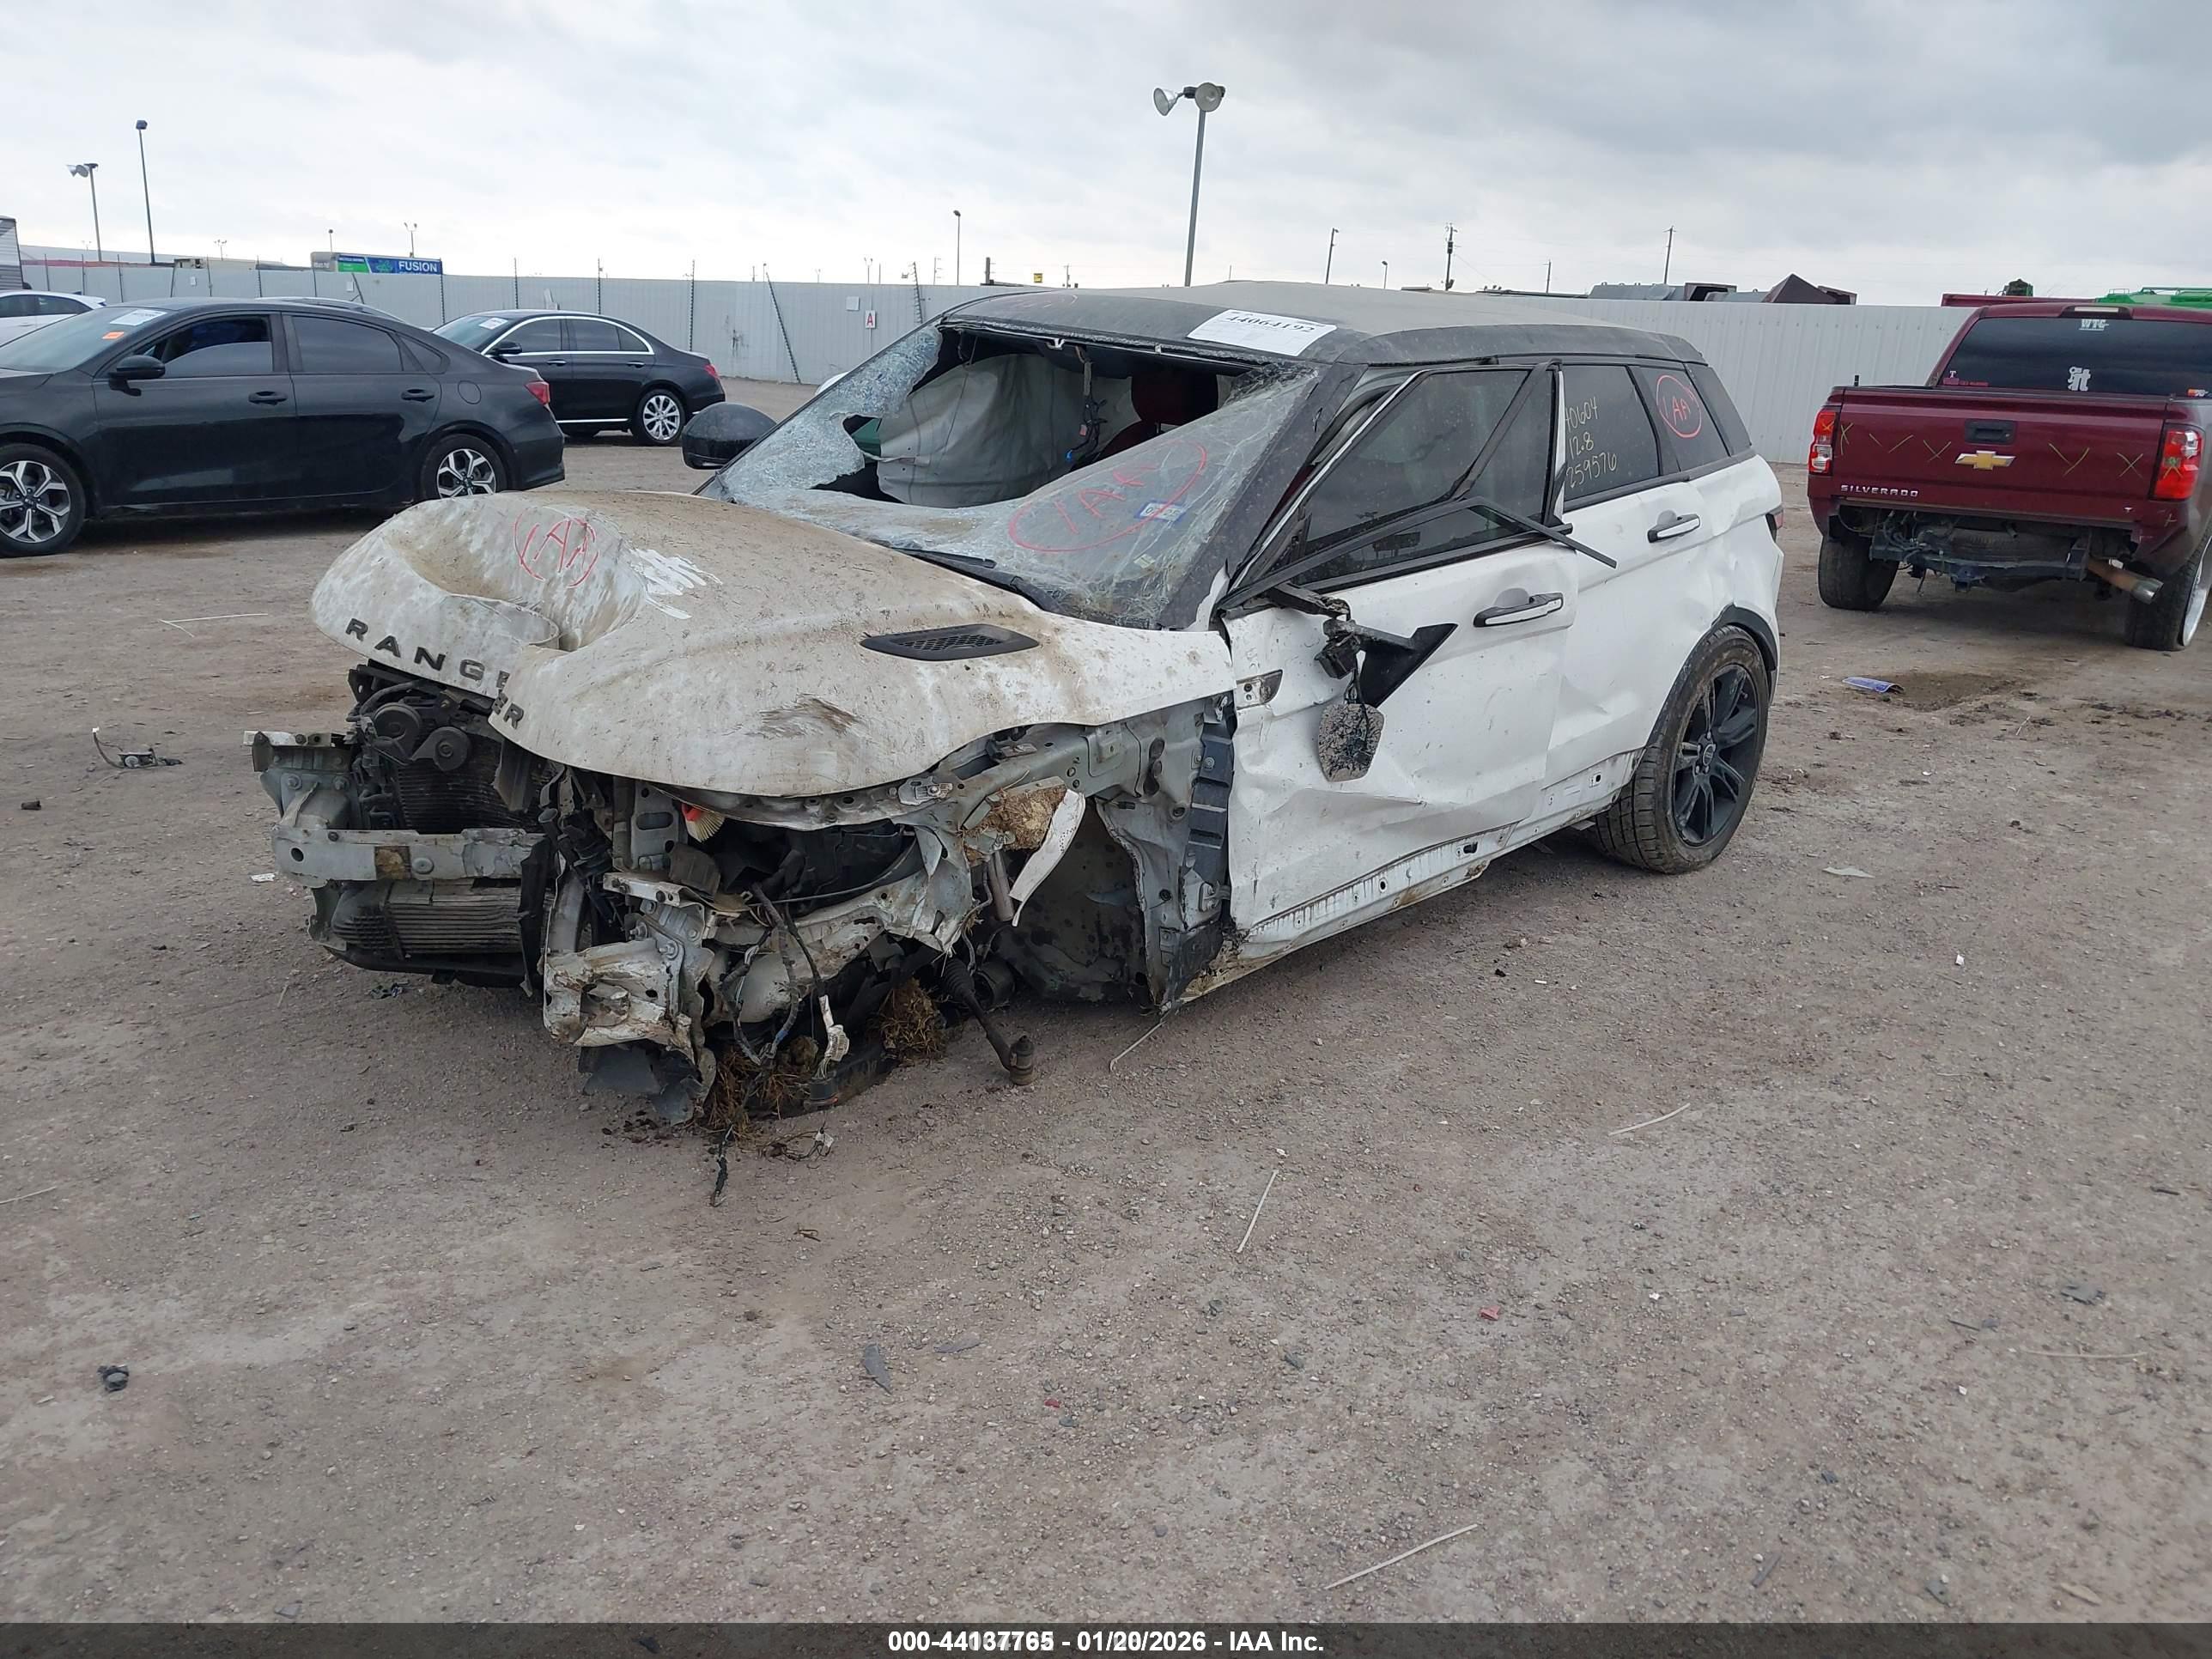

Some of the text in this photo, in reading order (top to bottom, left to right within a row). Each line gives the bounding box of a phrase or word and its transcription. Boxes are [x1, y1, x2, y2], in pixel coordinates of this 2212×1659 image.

[398, 260, 438, 273] FUSION
[866, 313, 873, 326] A
[1226, 315, 1316, 333] 44064192
[1569, 431, 1595, 460] 12.8
[1565, 451, 1618, 489] 259576
[1840, 484, 1919, 497] SILVERADO
